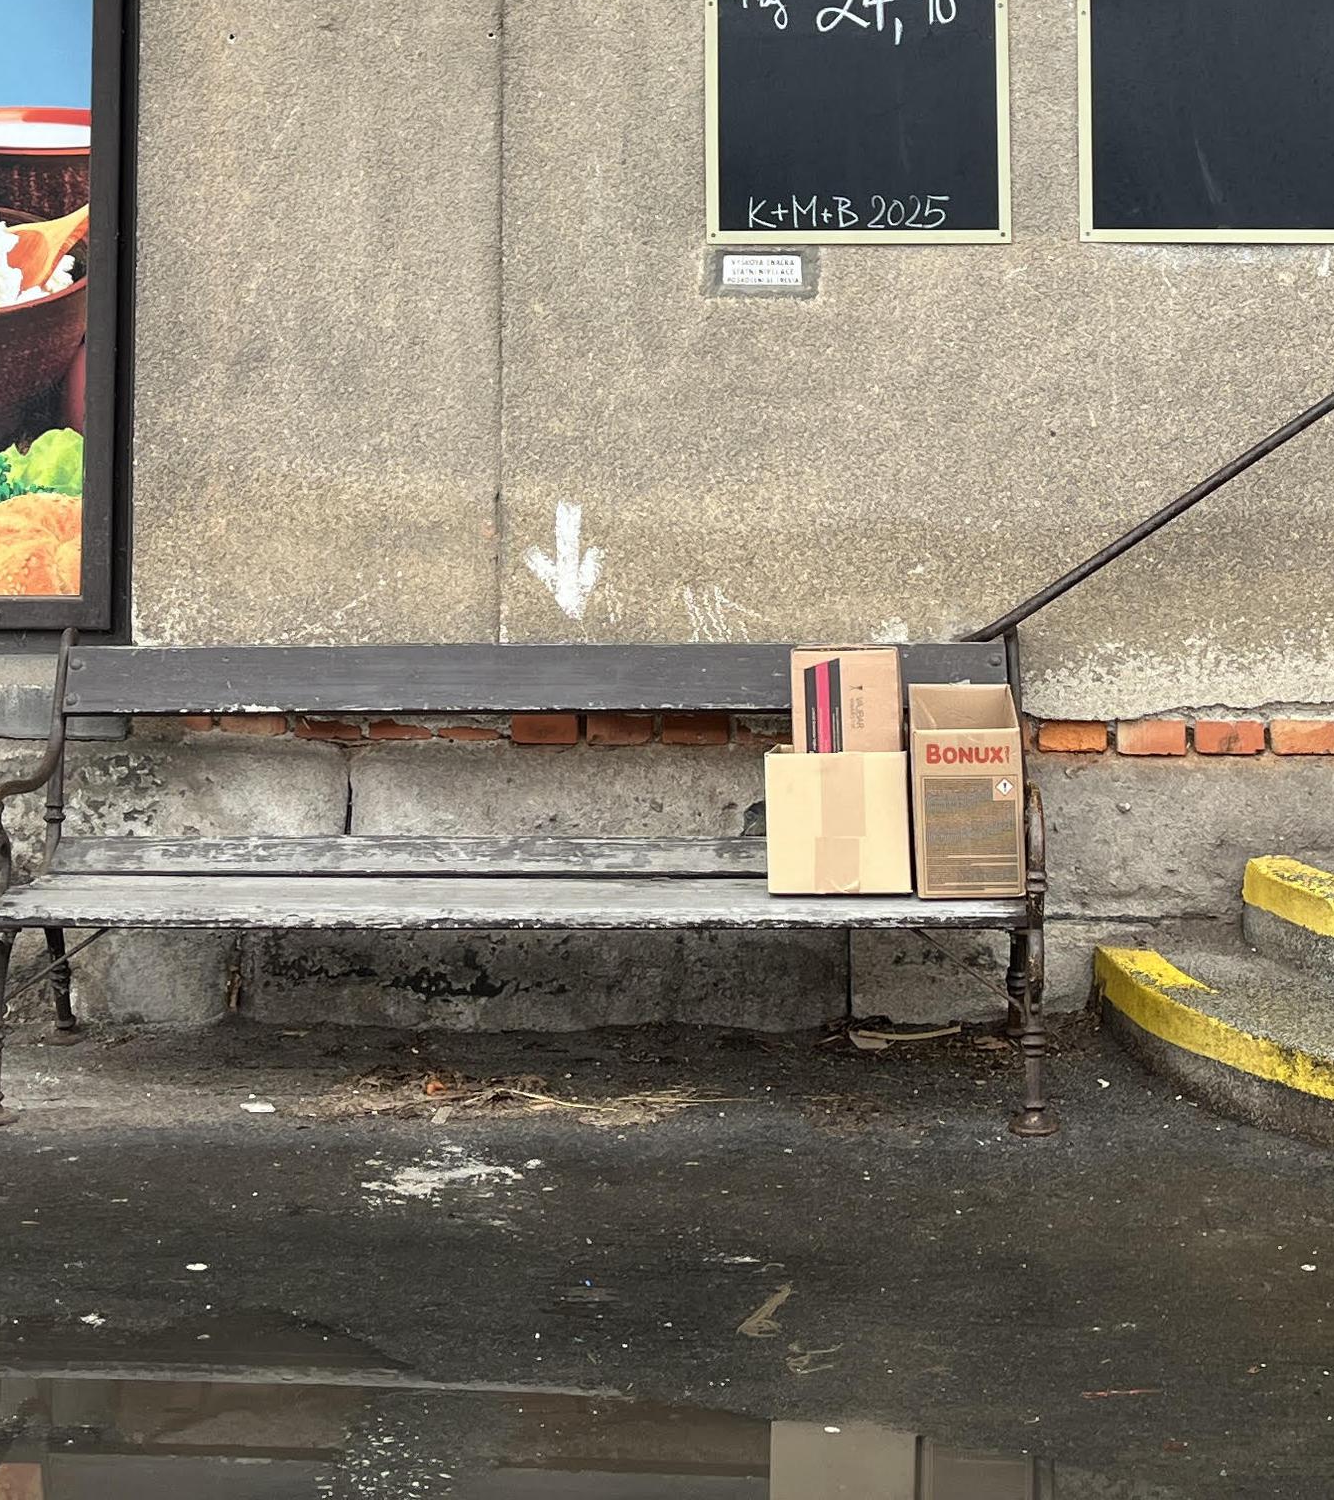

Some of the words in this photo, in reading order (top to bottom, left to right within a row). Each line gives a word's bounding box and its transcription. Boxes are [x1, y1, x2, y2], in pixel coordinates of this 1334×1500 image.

[748, 196, 858, 229] K+M+B
[867, 195, 951, 230] 2025
[926, 743, 1004, 765] BONUX
